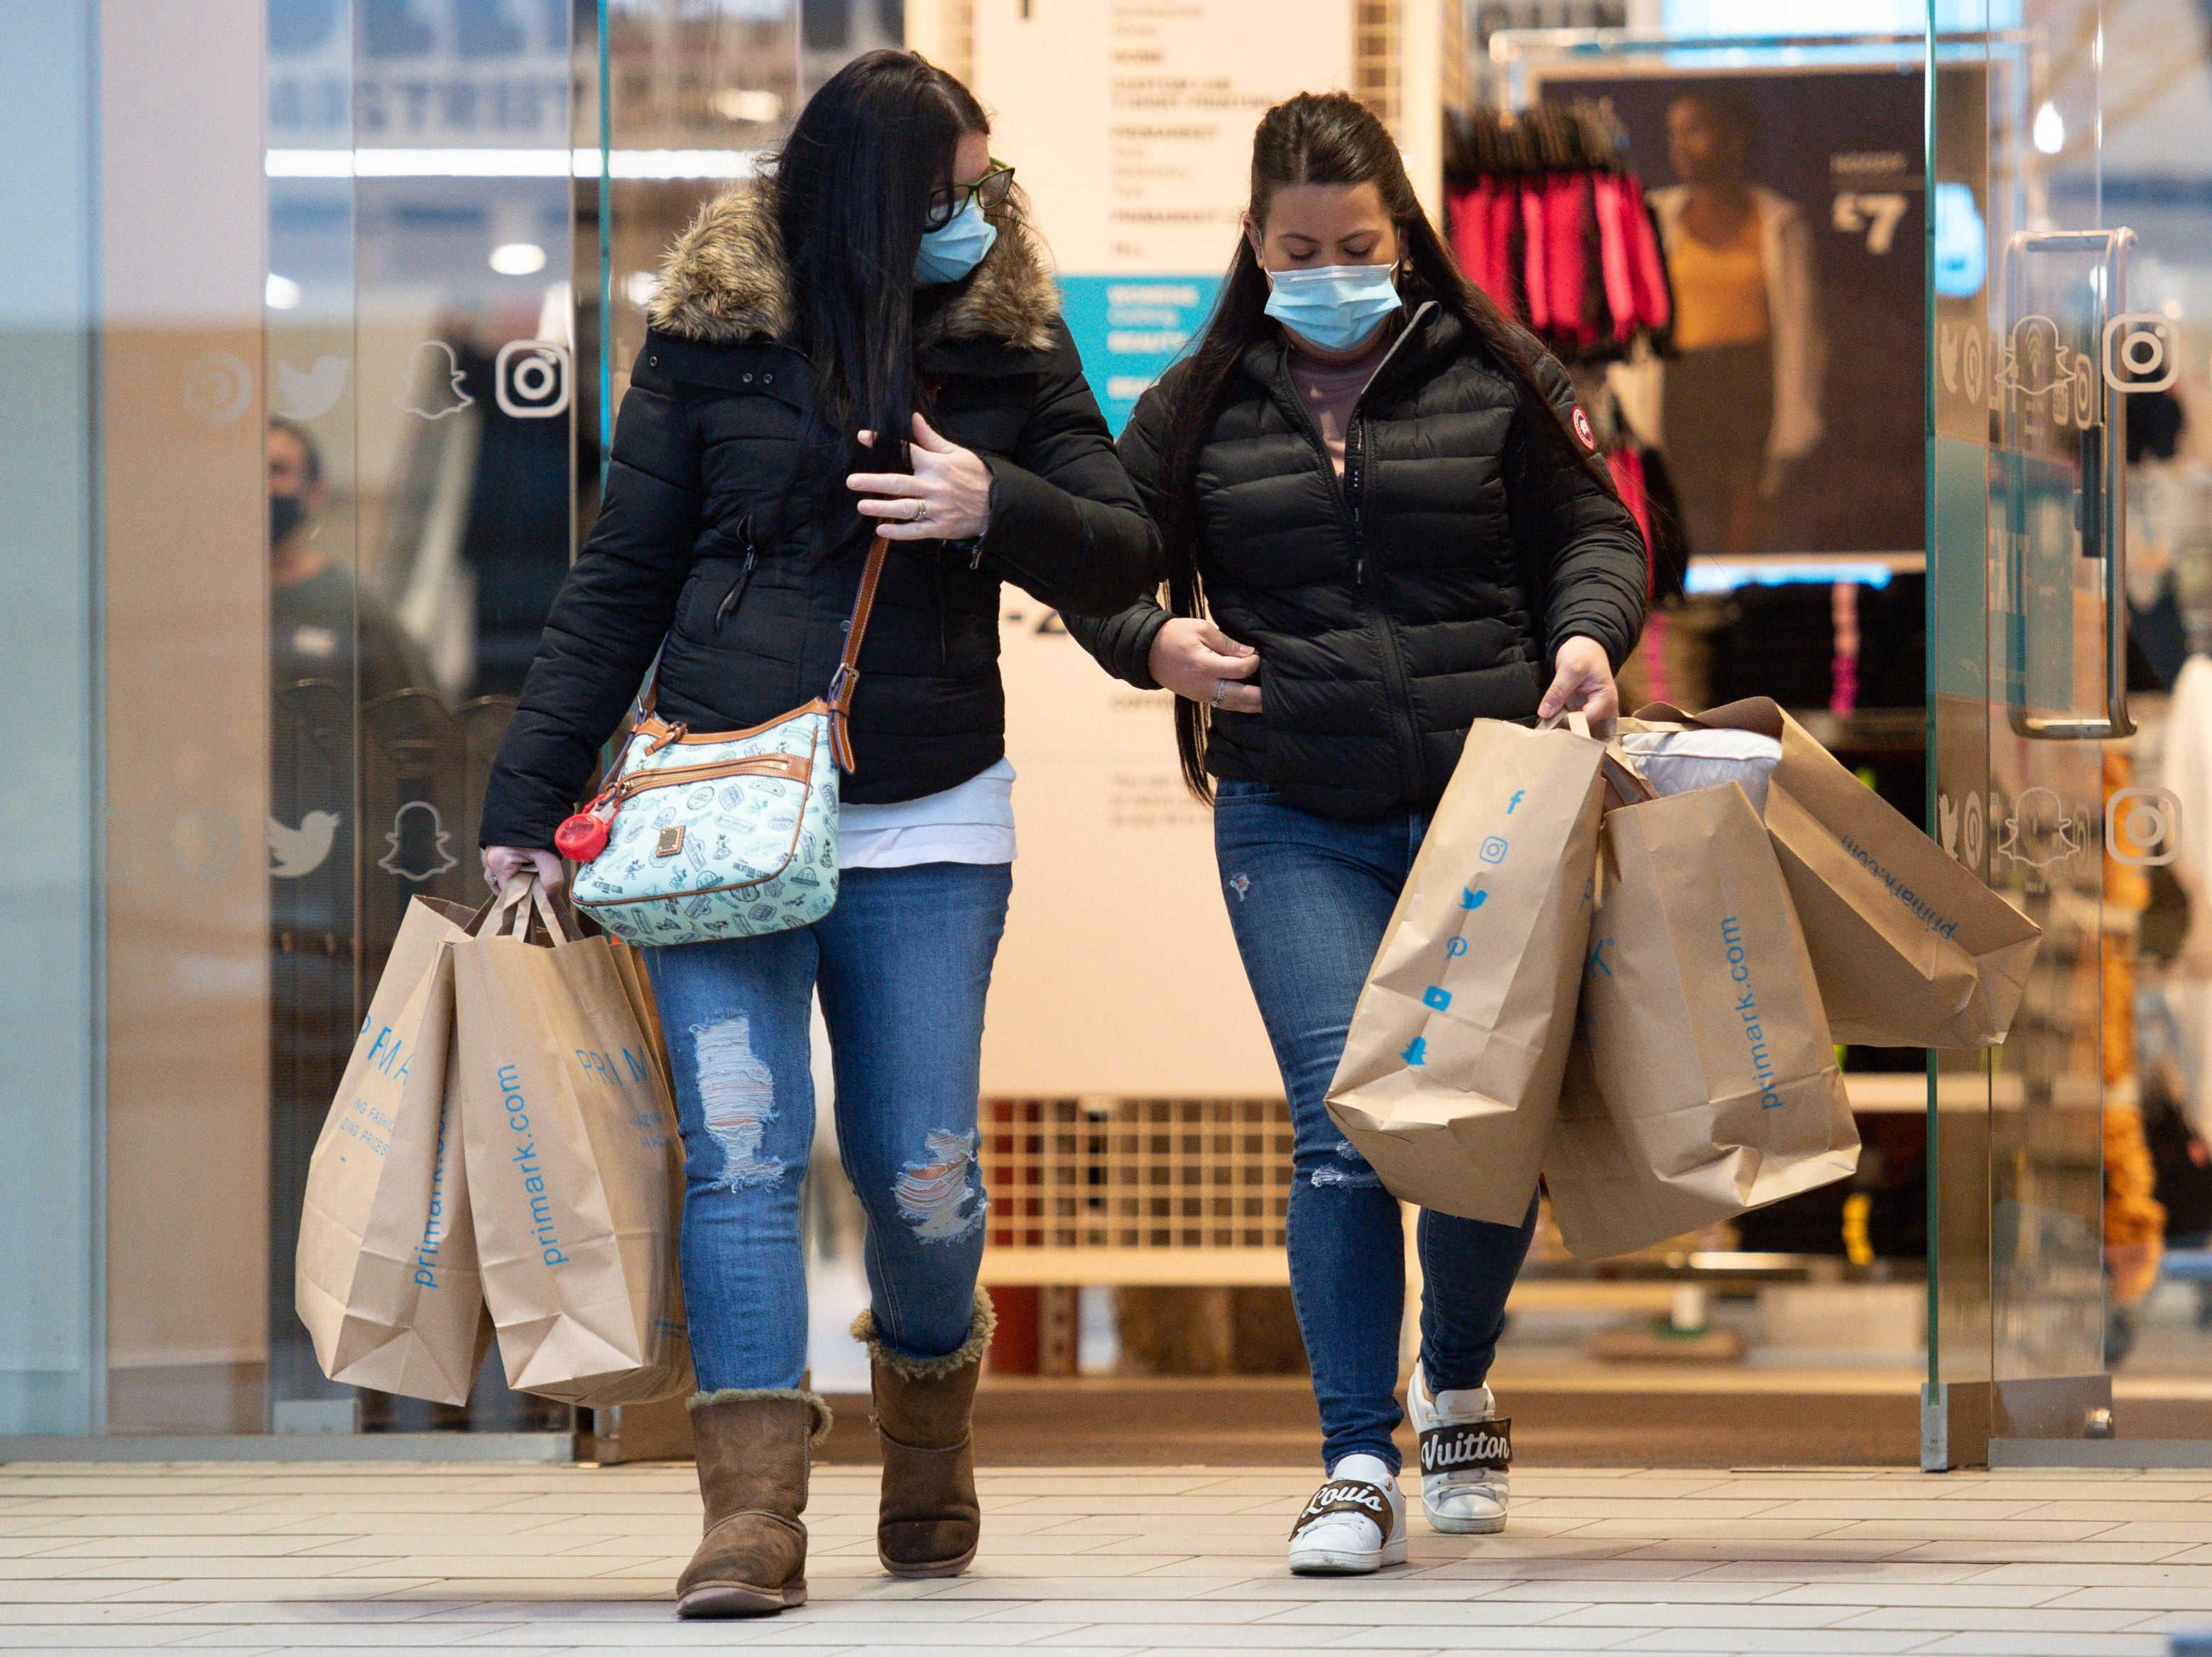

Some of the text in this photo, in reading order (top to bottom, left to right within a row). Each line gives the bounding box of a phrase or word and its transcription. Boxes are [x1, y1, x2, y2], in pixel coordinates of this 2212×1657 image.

[1721, 916, 1785, 1111] primark.com
[497, 1064, 570, 1267] primark.com
[1302, 1484, 1383, 1519] Louis
[1421, 1432, 1510, 1472] Vuitton
